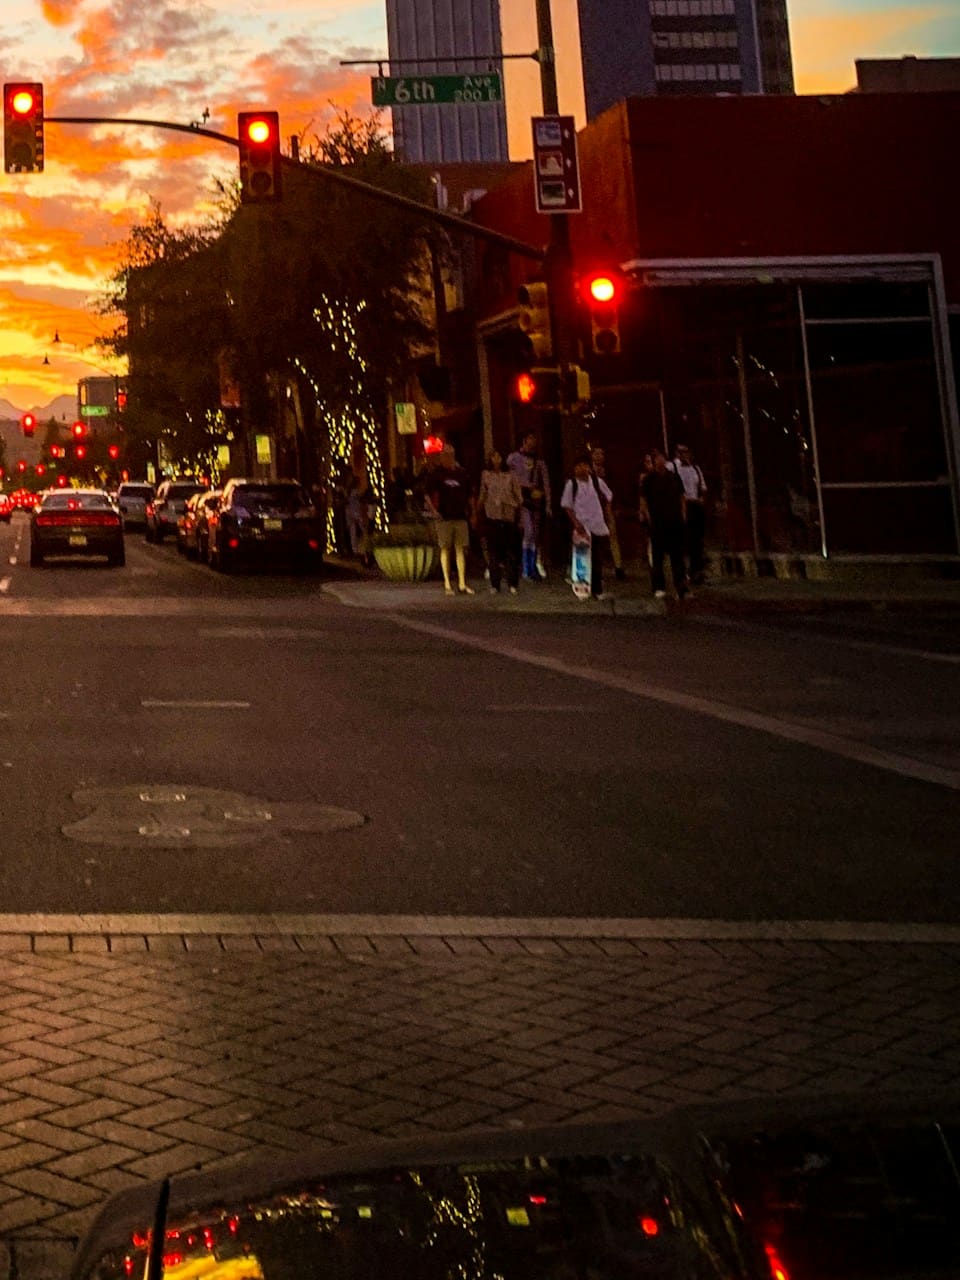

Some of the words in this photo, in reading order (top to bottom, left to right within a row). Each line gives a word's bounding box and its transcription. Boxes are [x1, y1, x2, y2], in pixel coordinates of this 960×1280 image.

[377, 78, 387, 91] N
[395, 80, 436, 103] 6th
[463, 76, 492, 89] Ave
[454, 88, 483, 102] 200
